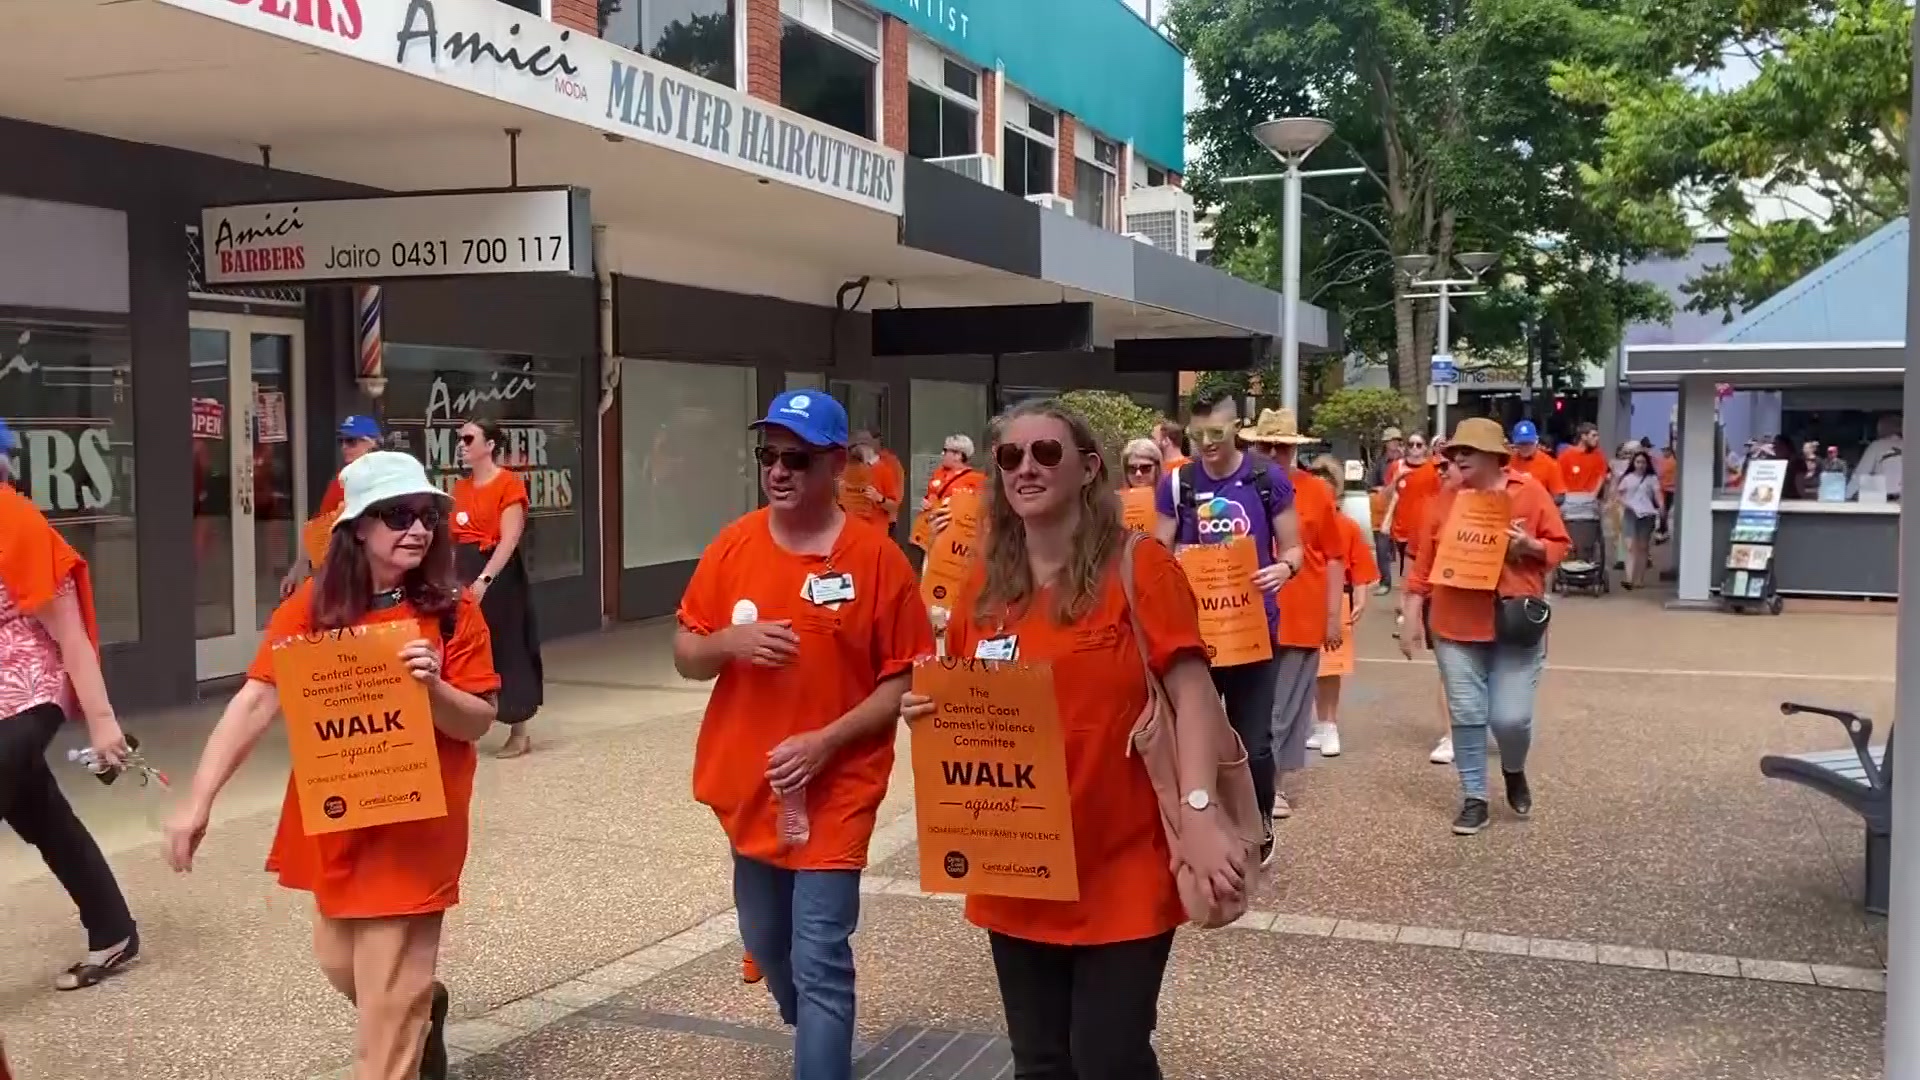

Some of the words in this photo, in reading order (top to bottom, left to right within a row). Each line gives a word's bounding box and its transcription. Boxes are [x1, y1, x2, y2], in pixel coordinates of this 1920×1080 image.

[396, 0, 578, 77] Amici
[555, 77, 588, 101] MODA
[606, 59, 733, 154] MASTER
[739, 97, 896, 204] HAIRCUTTERS
[214, 207, 304, 255] Amici
[220, 245, 305, 274] BARBERS
[325, 242, 381, 270] Jairo
[391, 241, 448, 267] 0431
[462, 239, 507, 265] 700
[517, 236, 562, 262] 117
[425, 362, 537, 428] Amici
[1198, 517, 1247, 534] acon
[1456, 530, 1499, 545] WALK
[1201, 591, 1251, 611] WALK
[337, 653, 358, 664] The
[311, 666, 353, 682] Central
[355, 663, 388, 676] Coast
[303, 681, 353, 698] Domestic
[356, 676, 402, 688] Violence
[968, 687, 990, 699] The
[324, 692, 384, 708] Committee
[944, 703, 985, 715] Central
[987, 705, 1020, 717] Coast
[314, 709, 405, 741] WALK
[933, 718, 985, 731] Domestic
[988, 721, 1036, 733] Violence
[340, 739, 390, 765] against
[953, 735, 1017, 749] Committee
[941, 760, 1037, 789] WALK
[965, 796, 1018, 820] against
[1019, 831, 1061, 841] VIOLENCE
